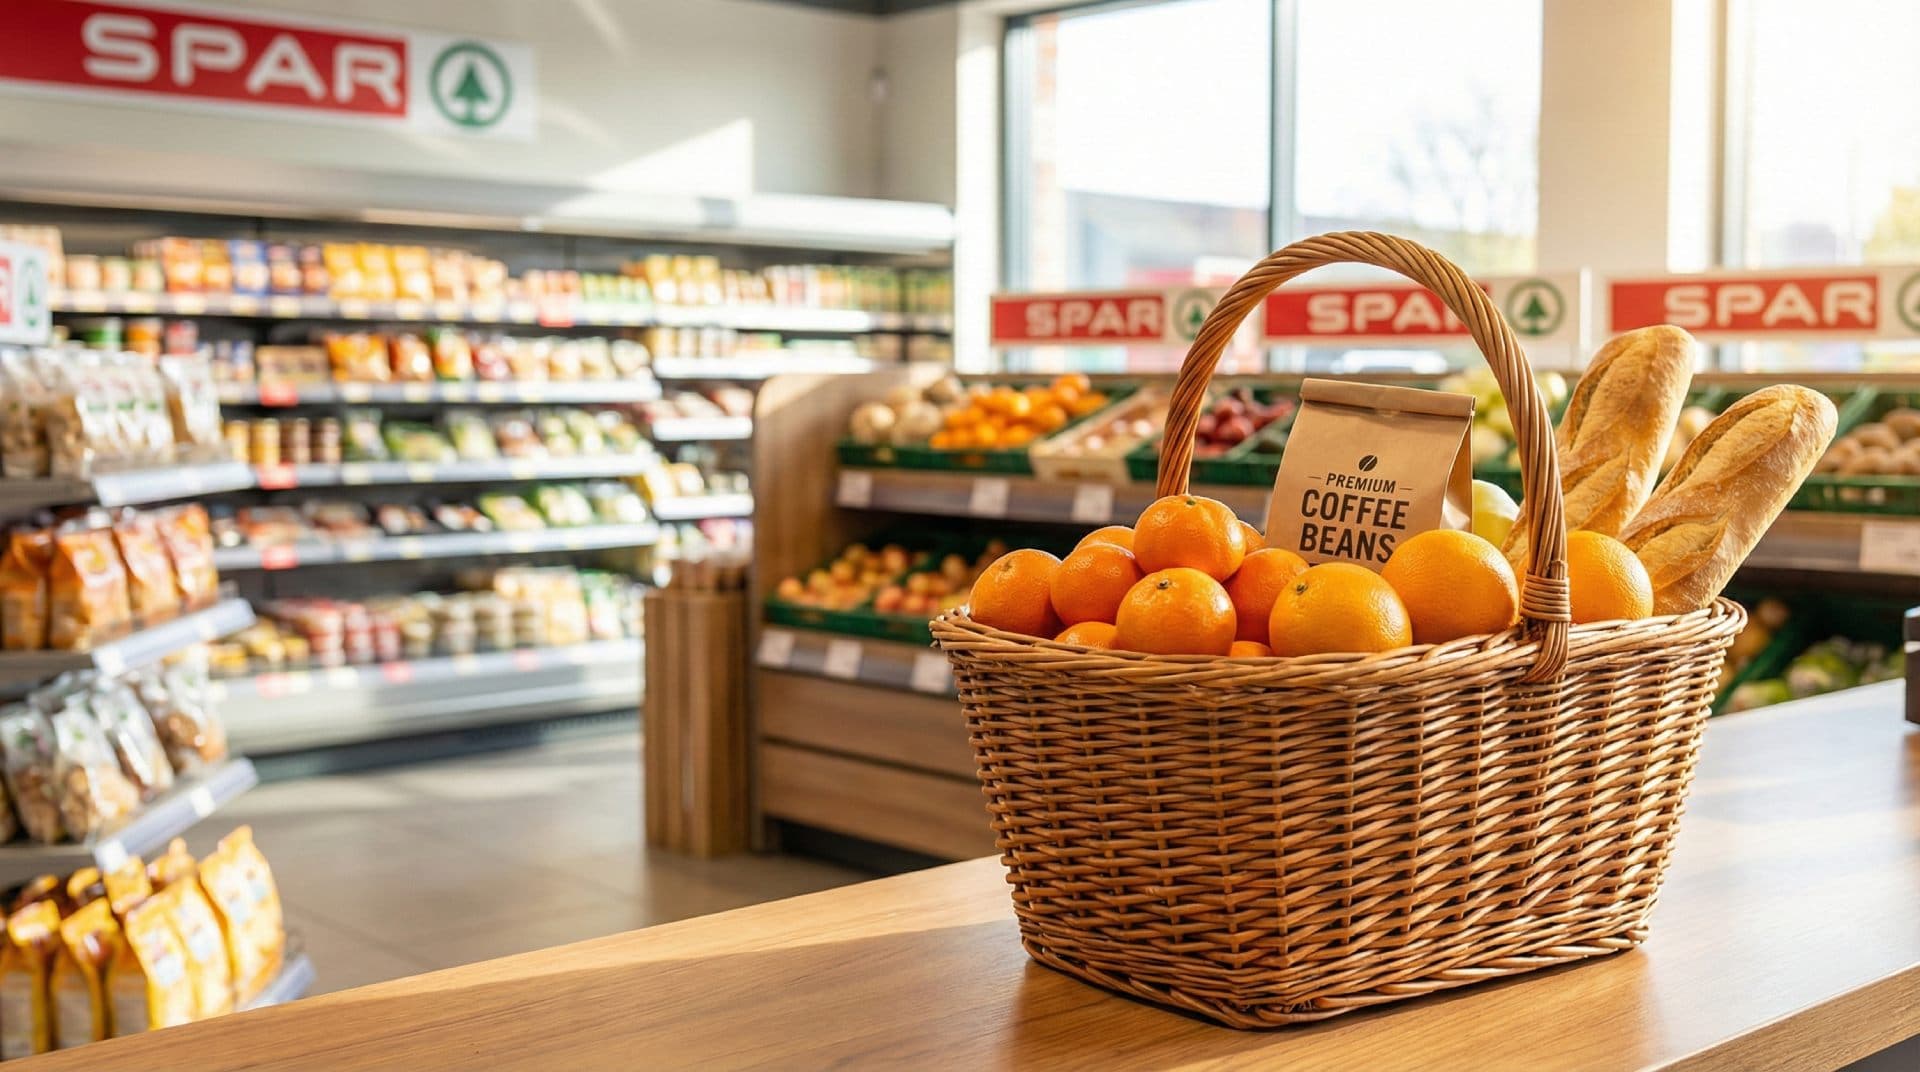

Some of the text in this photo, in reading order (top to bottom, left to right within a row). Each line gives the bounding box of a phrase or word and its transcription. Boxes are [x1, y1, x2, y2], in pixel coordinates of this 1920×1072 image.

[81, 13, 402, 107] SPAR
[1025, 300, 1163, 337] SPAR
[1664, 281, 1873, 327] SPAR
[1326, 473, 1396, 493] PREMIUM
[1301, 489, 1410, 530] COFFEE
[1300, 523, 1396, 564] BEANS
